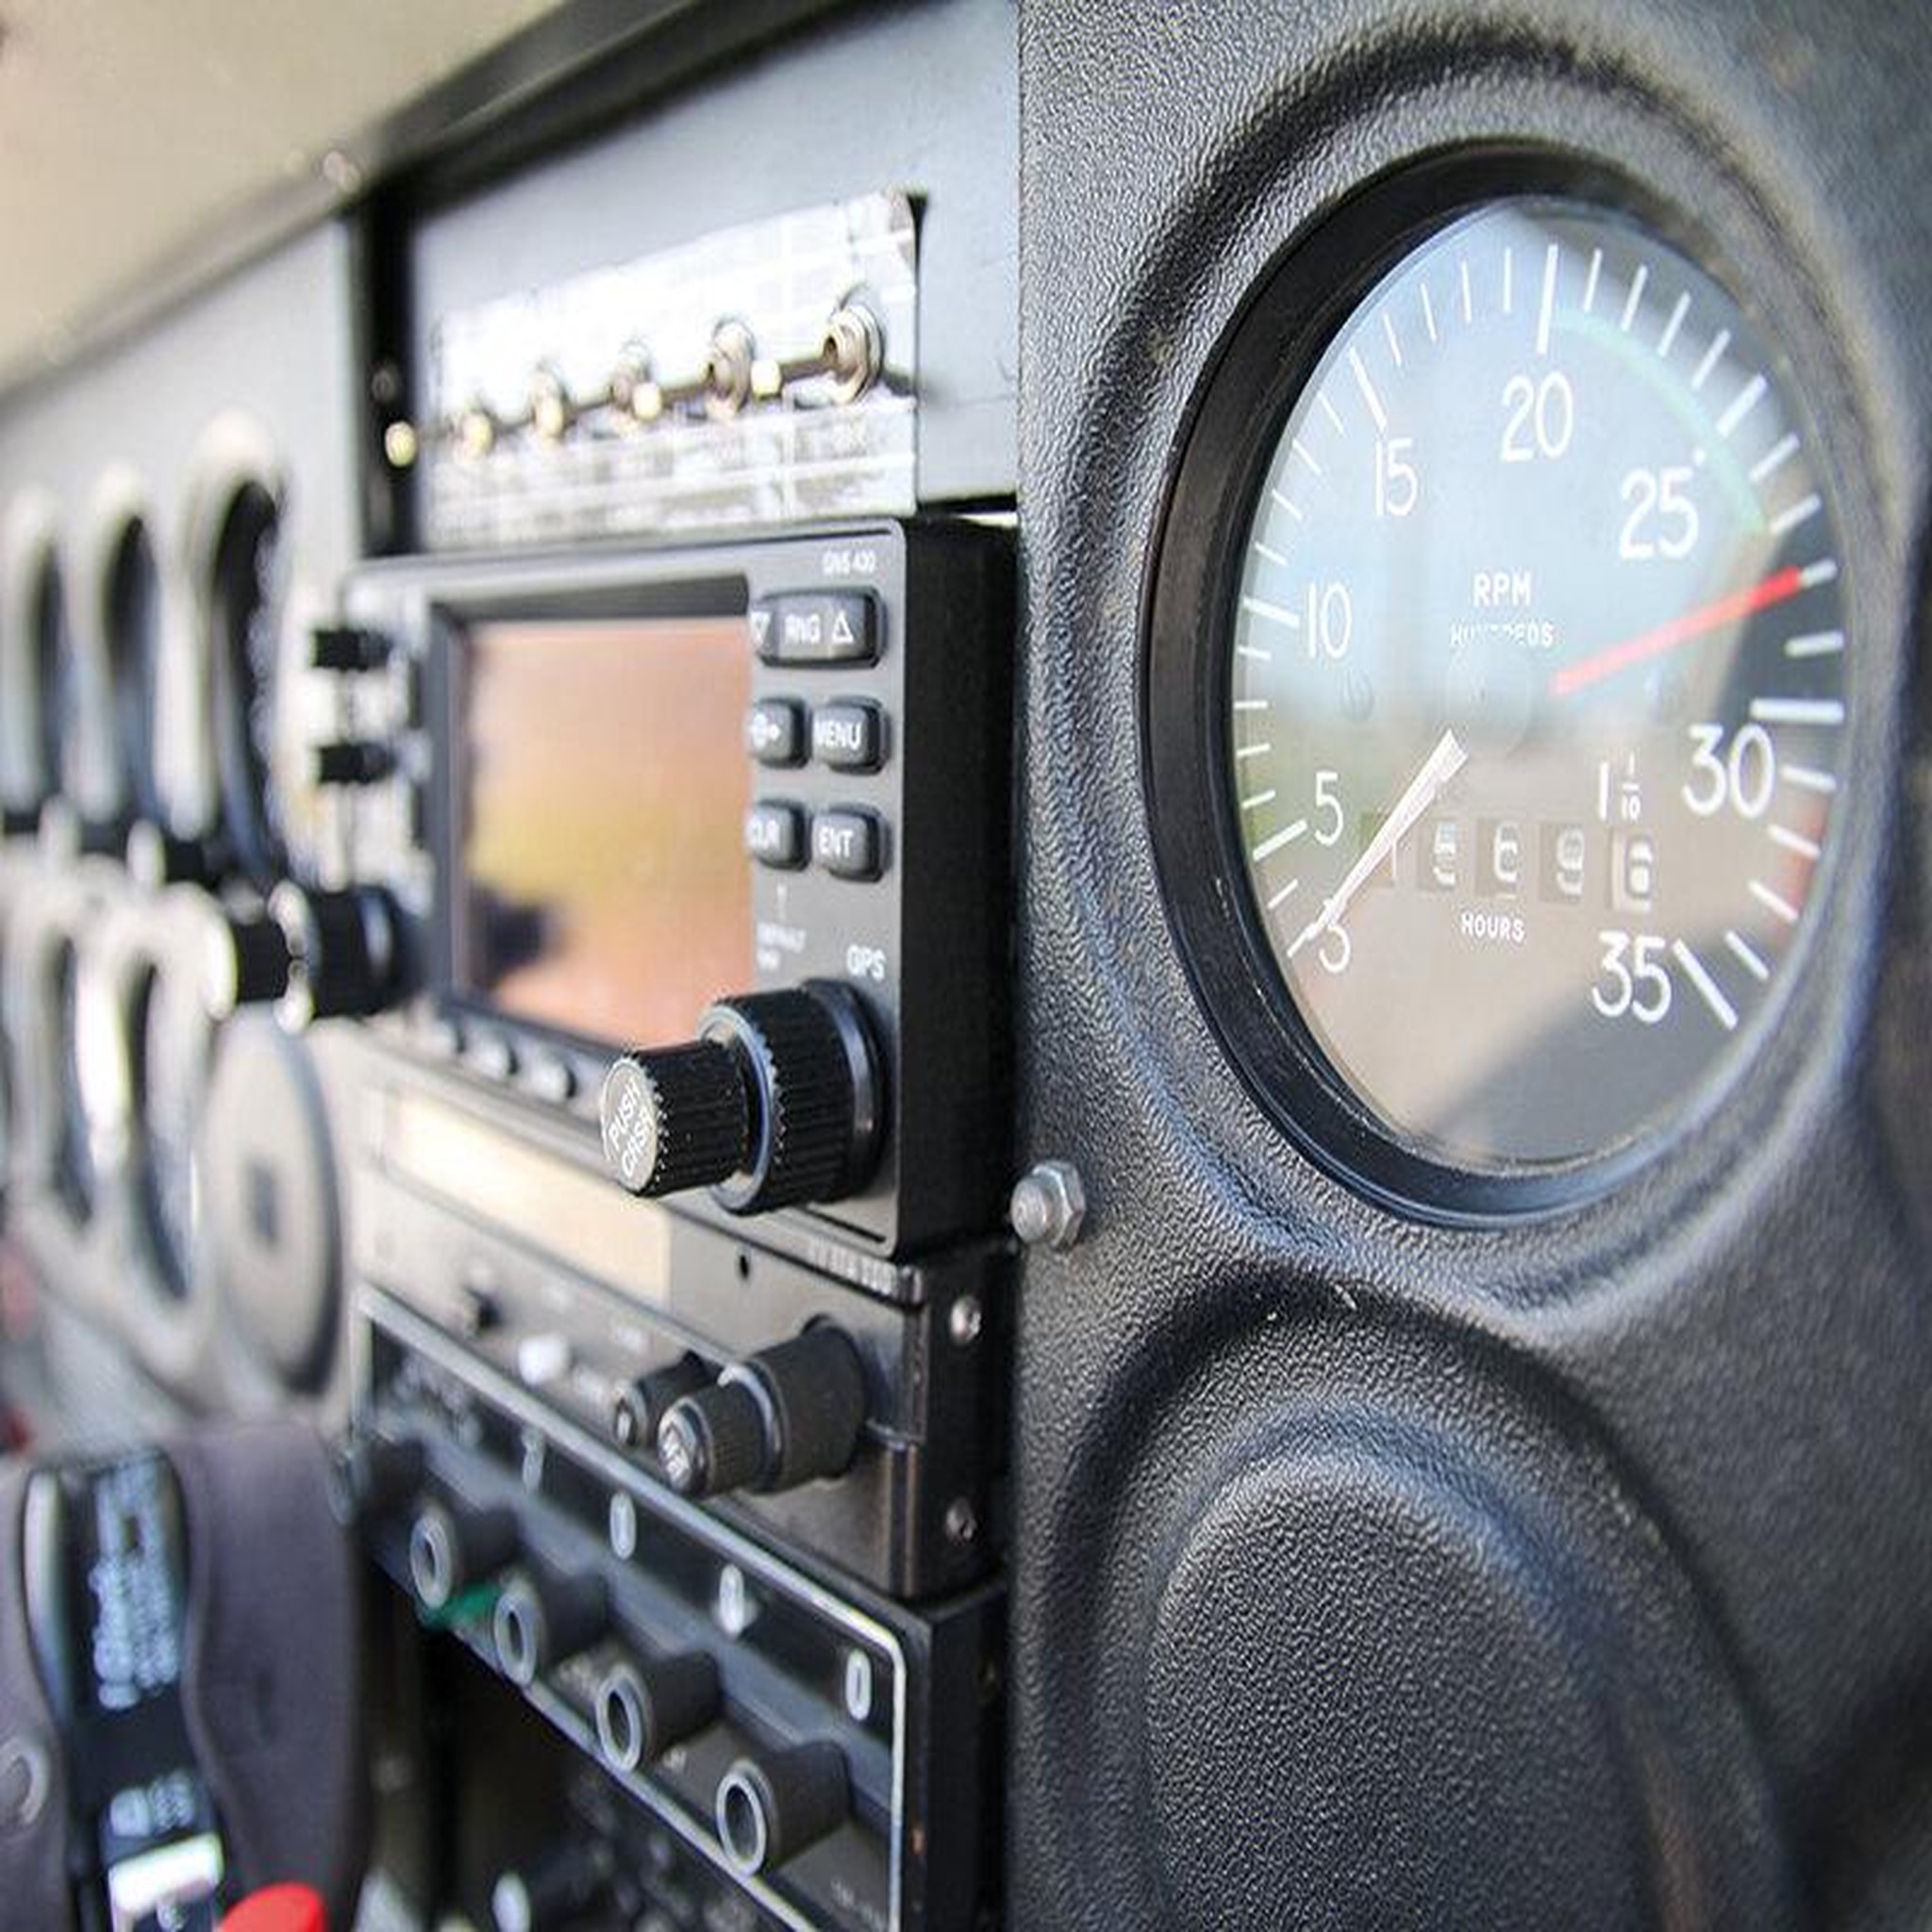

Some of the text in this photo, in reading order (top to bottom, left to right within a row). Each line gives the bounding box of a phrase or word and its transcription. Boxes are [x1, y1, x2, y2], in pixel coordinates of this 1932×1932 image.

[1500, 372, 1574, 462] 20
[1374, 438, 1418, 517] 15
[1618, 467, 1699, 558] 25
[1307, 582, 1353, 660] 10
[1473, 570, 1532, 608] RPM
[1314, 771, 1344, 846] 5
[1682, 724, 1775, 819] 30
[819, 826, 853, 858] ENT
[847, 944, 887, 981] GPS
[1461, 912, 1524, 943] HOURS
[1592, 931, 1673, 1024] 35
[608, 1076, 642, 1151] PUSH
